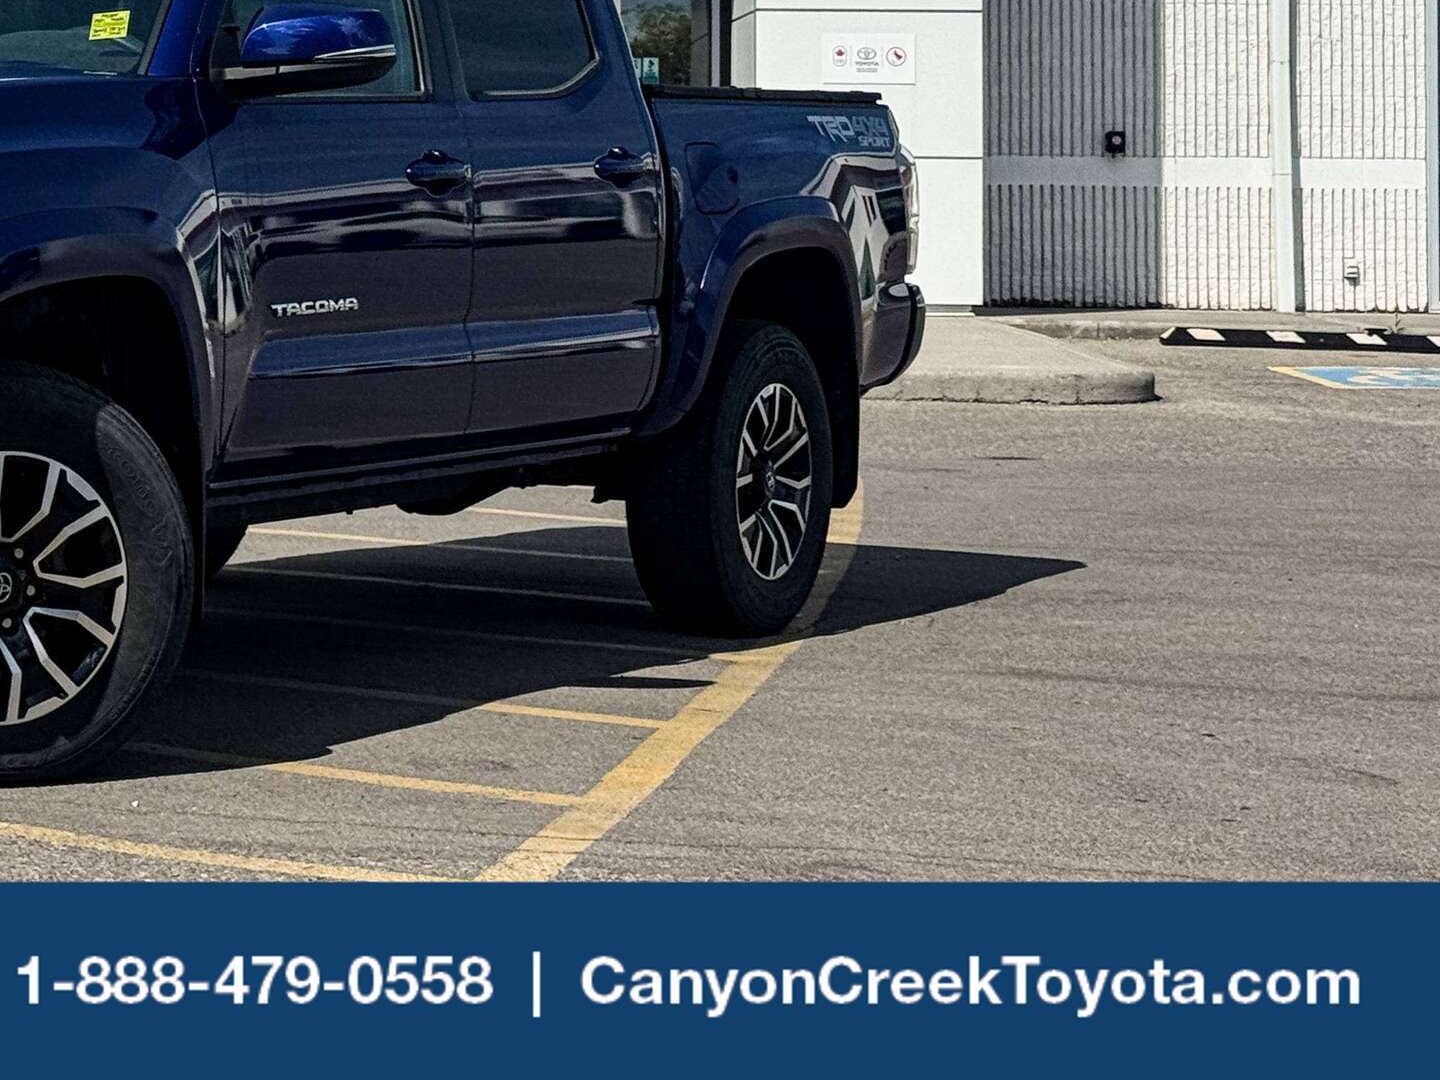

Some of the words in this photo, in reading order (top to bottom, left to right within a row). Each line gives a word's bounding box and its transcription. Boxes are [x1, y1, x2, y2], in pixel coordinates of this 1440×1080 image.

[806, 115, 855, 142] TRD
[858, 135, 890, 147] SPORT
[271, 297, 360, 318] TACOMA
